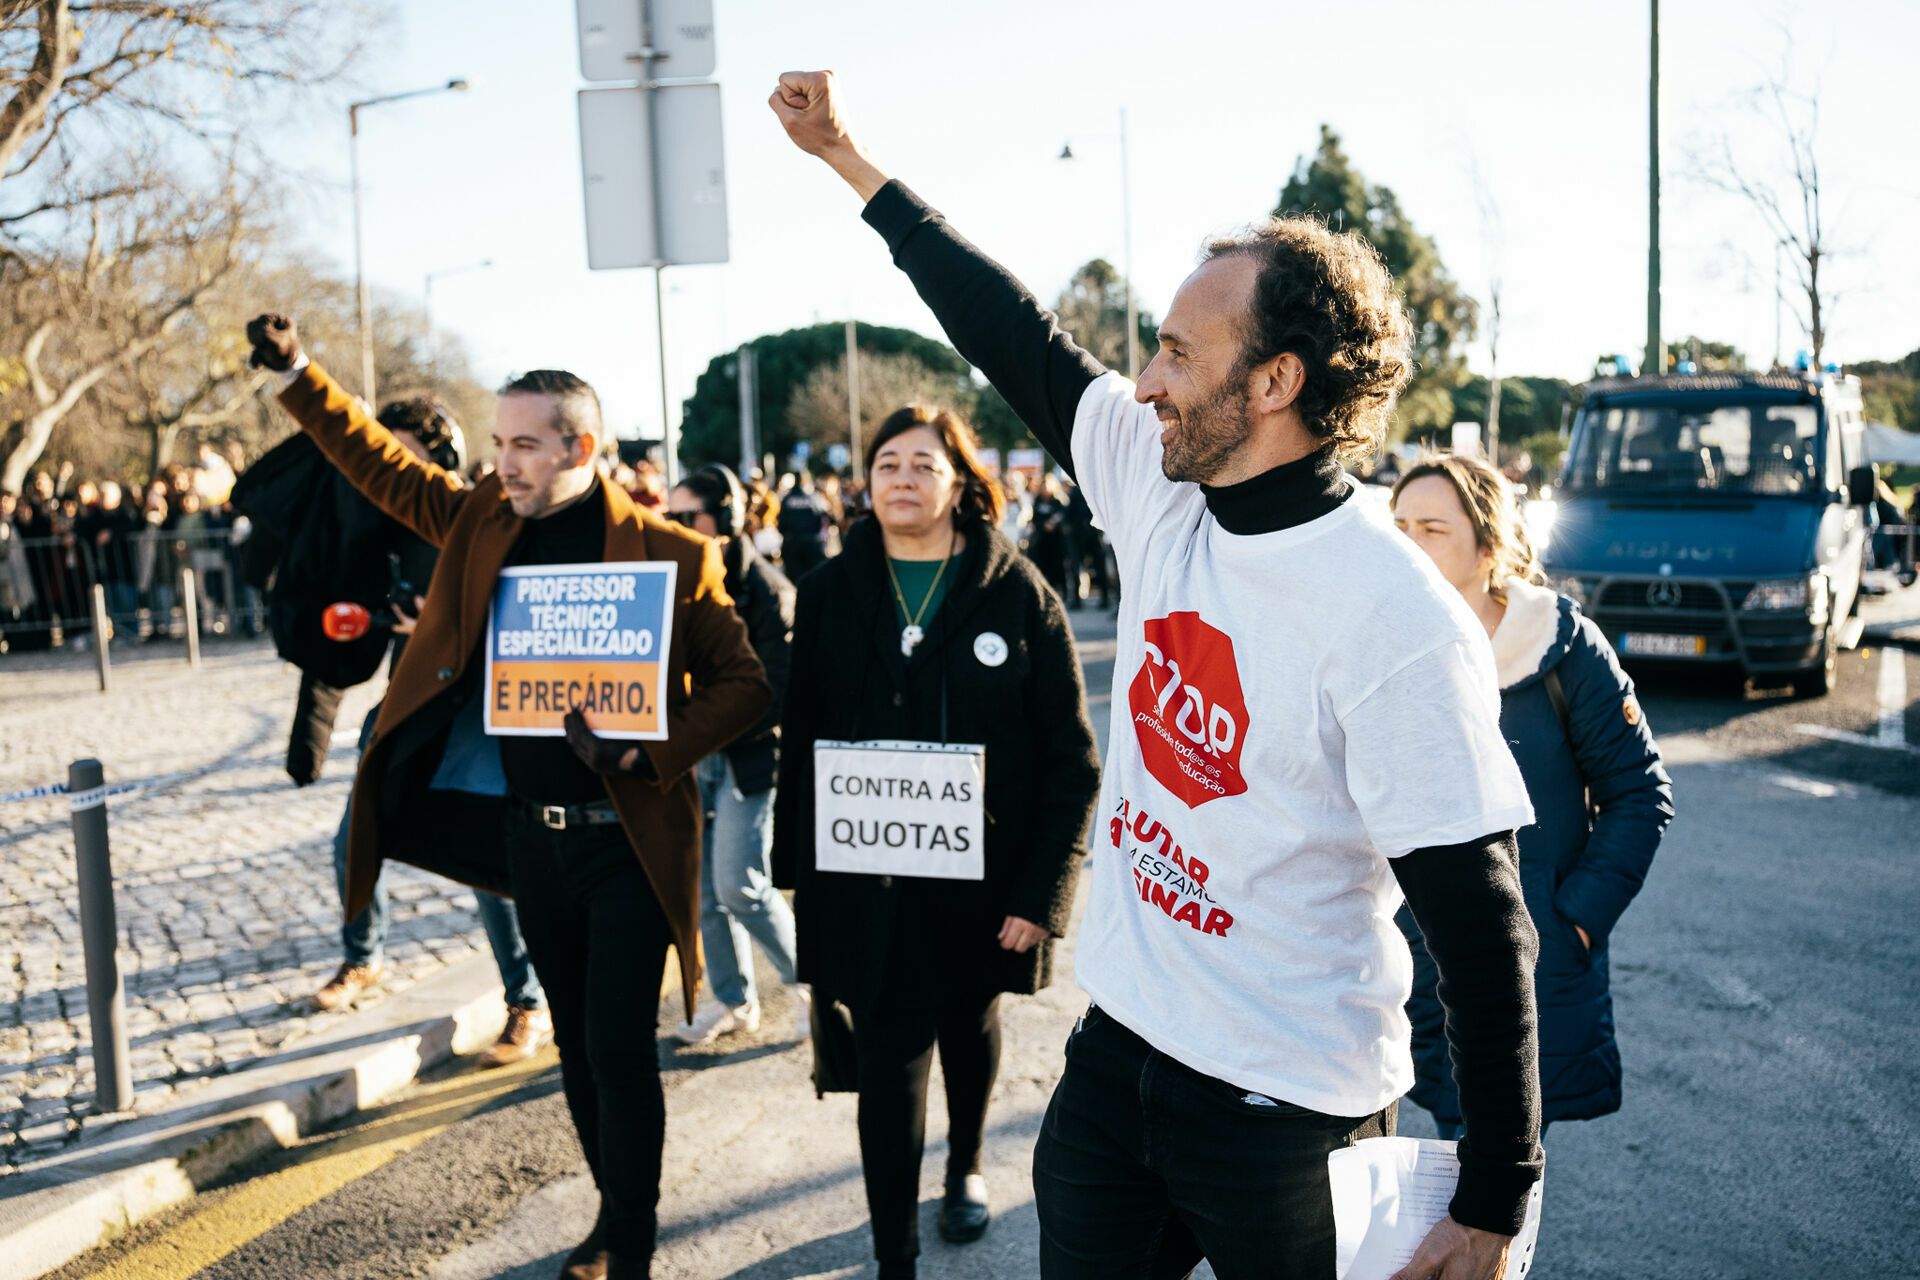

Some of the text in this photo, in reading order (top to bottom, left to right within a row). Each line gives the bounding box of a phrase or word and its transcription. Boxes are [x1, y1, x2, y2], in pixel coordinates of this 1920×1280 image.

[517, 575, 636, 603] PROFESSOR
[529, 602, 618, 631] TÉCNICO
[498, 629, 653, 656] ESPECIALIZADO
[497, 672, 653, 715] É PRECÁRIO.
[1175, 740, 1206, 767] tod@s
[1205, 764, 1222, 778] @s
[830, 775, 972, 802] CONTRA AS
[1178, 761, 1225, 794] educação
[832, 818, 970, 852] QUOTAS
[1125, 799, 1209, 892] LUTAR
